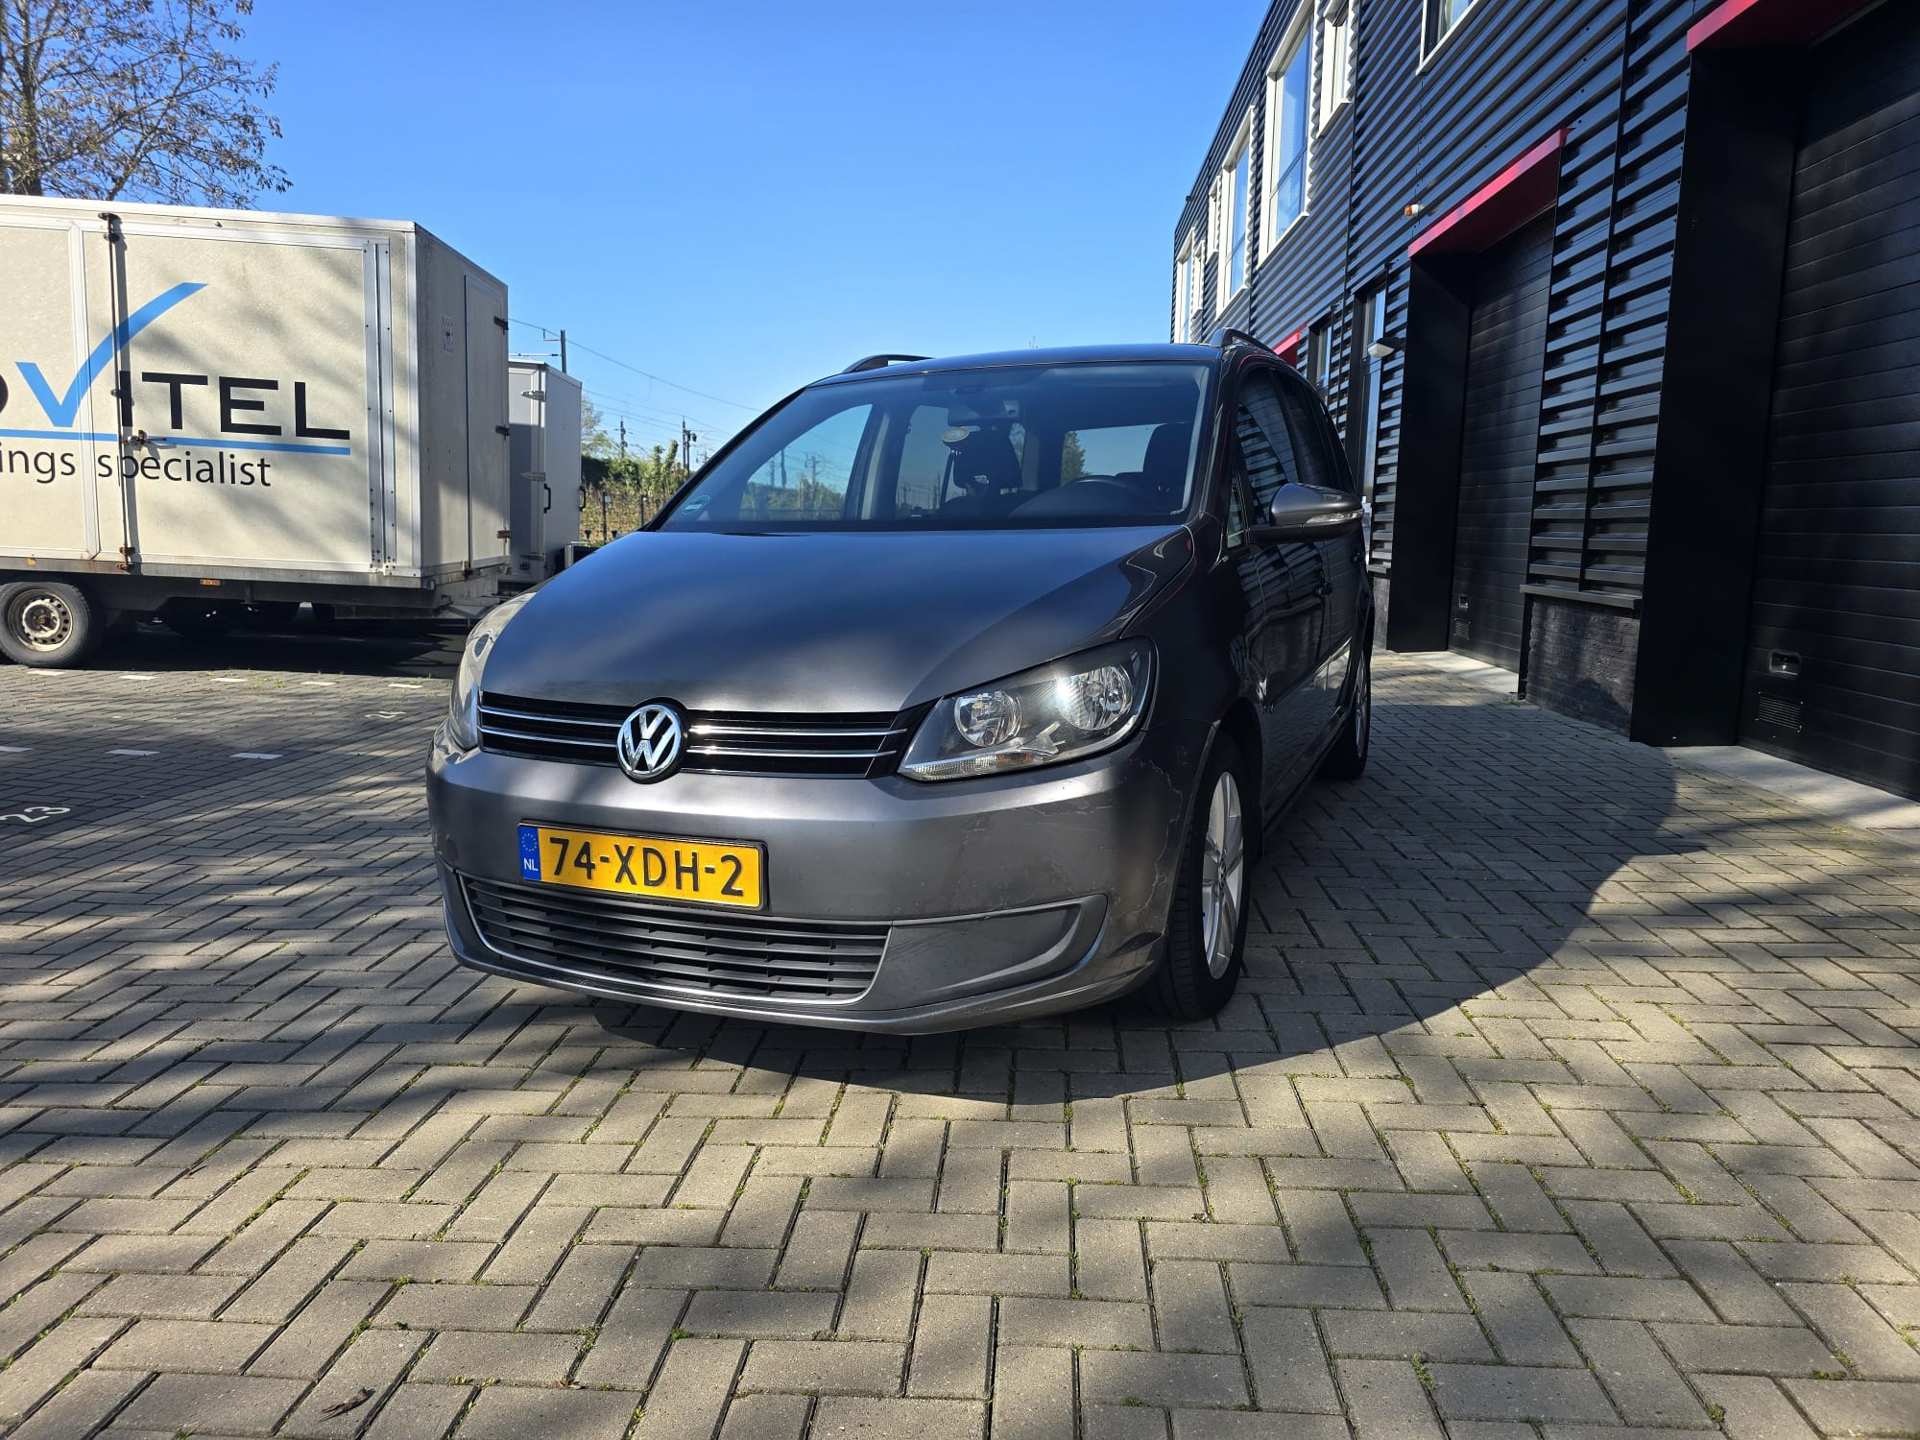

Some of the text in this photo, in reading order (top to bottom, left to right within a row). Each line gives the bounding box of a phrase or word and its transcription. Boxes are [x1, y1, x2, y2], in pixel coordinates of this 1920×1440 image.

[0, 282, 350, 440] VITEL
[97, 450, 272, 488] specialist
[0, 806, 71, 823] 23
[523, 857, 539, 872] NL
[549, 836, 744, 897] 74-XDH-2
